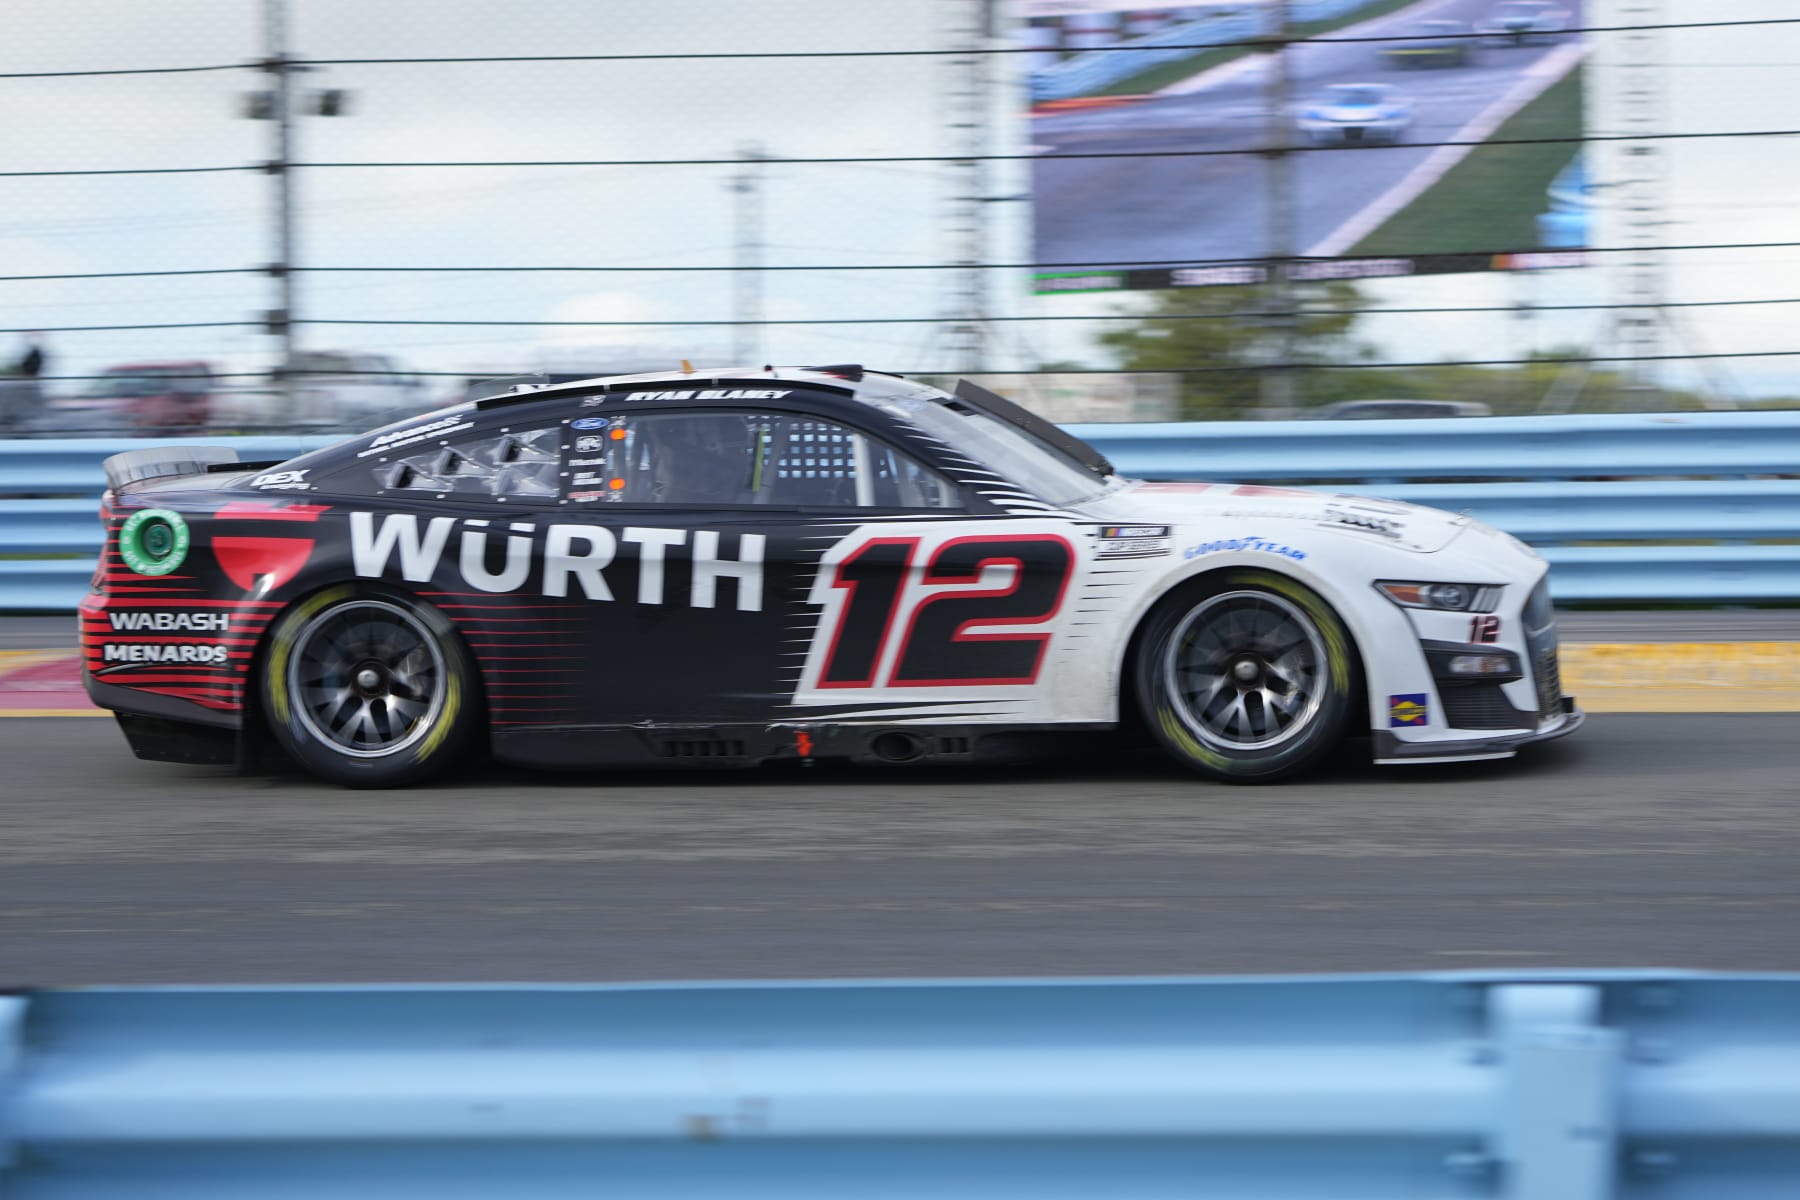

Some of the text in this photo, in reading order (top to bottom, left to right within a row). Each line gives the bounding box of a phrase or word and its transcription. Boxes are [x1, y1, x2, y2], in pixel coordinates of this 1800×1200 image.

[624, 390, 696, 401] RYAN
[350, 512, 765, 612] WÜRTH
[109, 612, 229, 631] WABASH
[816, 533, 1077, 690] 12
[1469, 615, 1500, 644] 12
[104, 644, 228, 662] MENARDS
